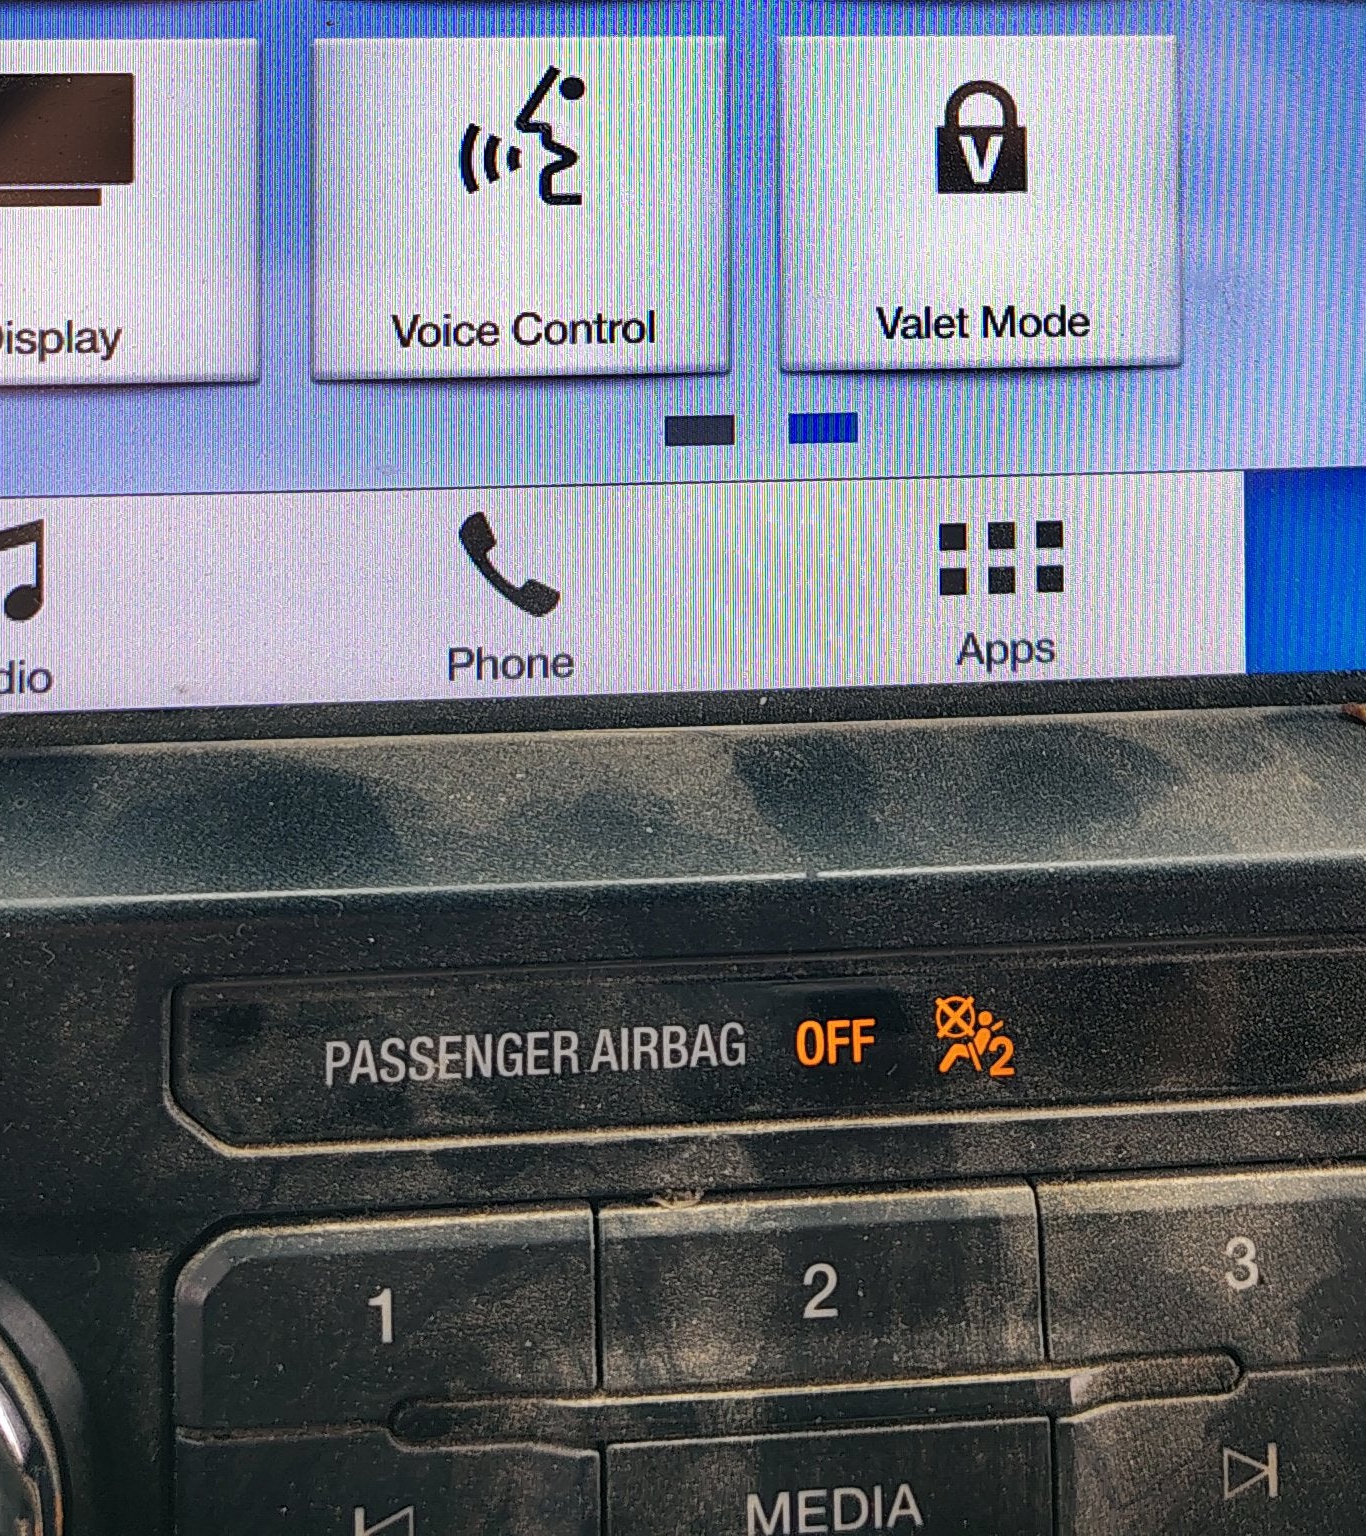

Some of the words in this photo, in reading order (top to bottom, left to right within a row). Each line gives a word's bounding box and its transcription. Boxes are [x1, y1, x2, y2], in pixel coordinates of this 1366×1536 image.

[958, 135, 1004, 184] V
[391, 313, 500, 349] Voice
[511, 309, 656, 347] Control
[875, 305, 970, 340] Valet
[982, 304, 1091, 339] Mode
[448, 646, 575, 682] Phone
[955, 631, 1056, 671] Apps
[325, 1030, 579, 1087] PASSENGER
[589, 1021, 746, 1073] AIRBAG
[796, 1018, 875, 1066] OFF
[989, 1035, 1015, 1077] 2
[1223, 1236, 1259, 1292] 3
[368, 1288, 392, 1343] 1
[803, 1263, 838, 1319] 2
[746, 1482, 923, 1536] MEDIA
